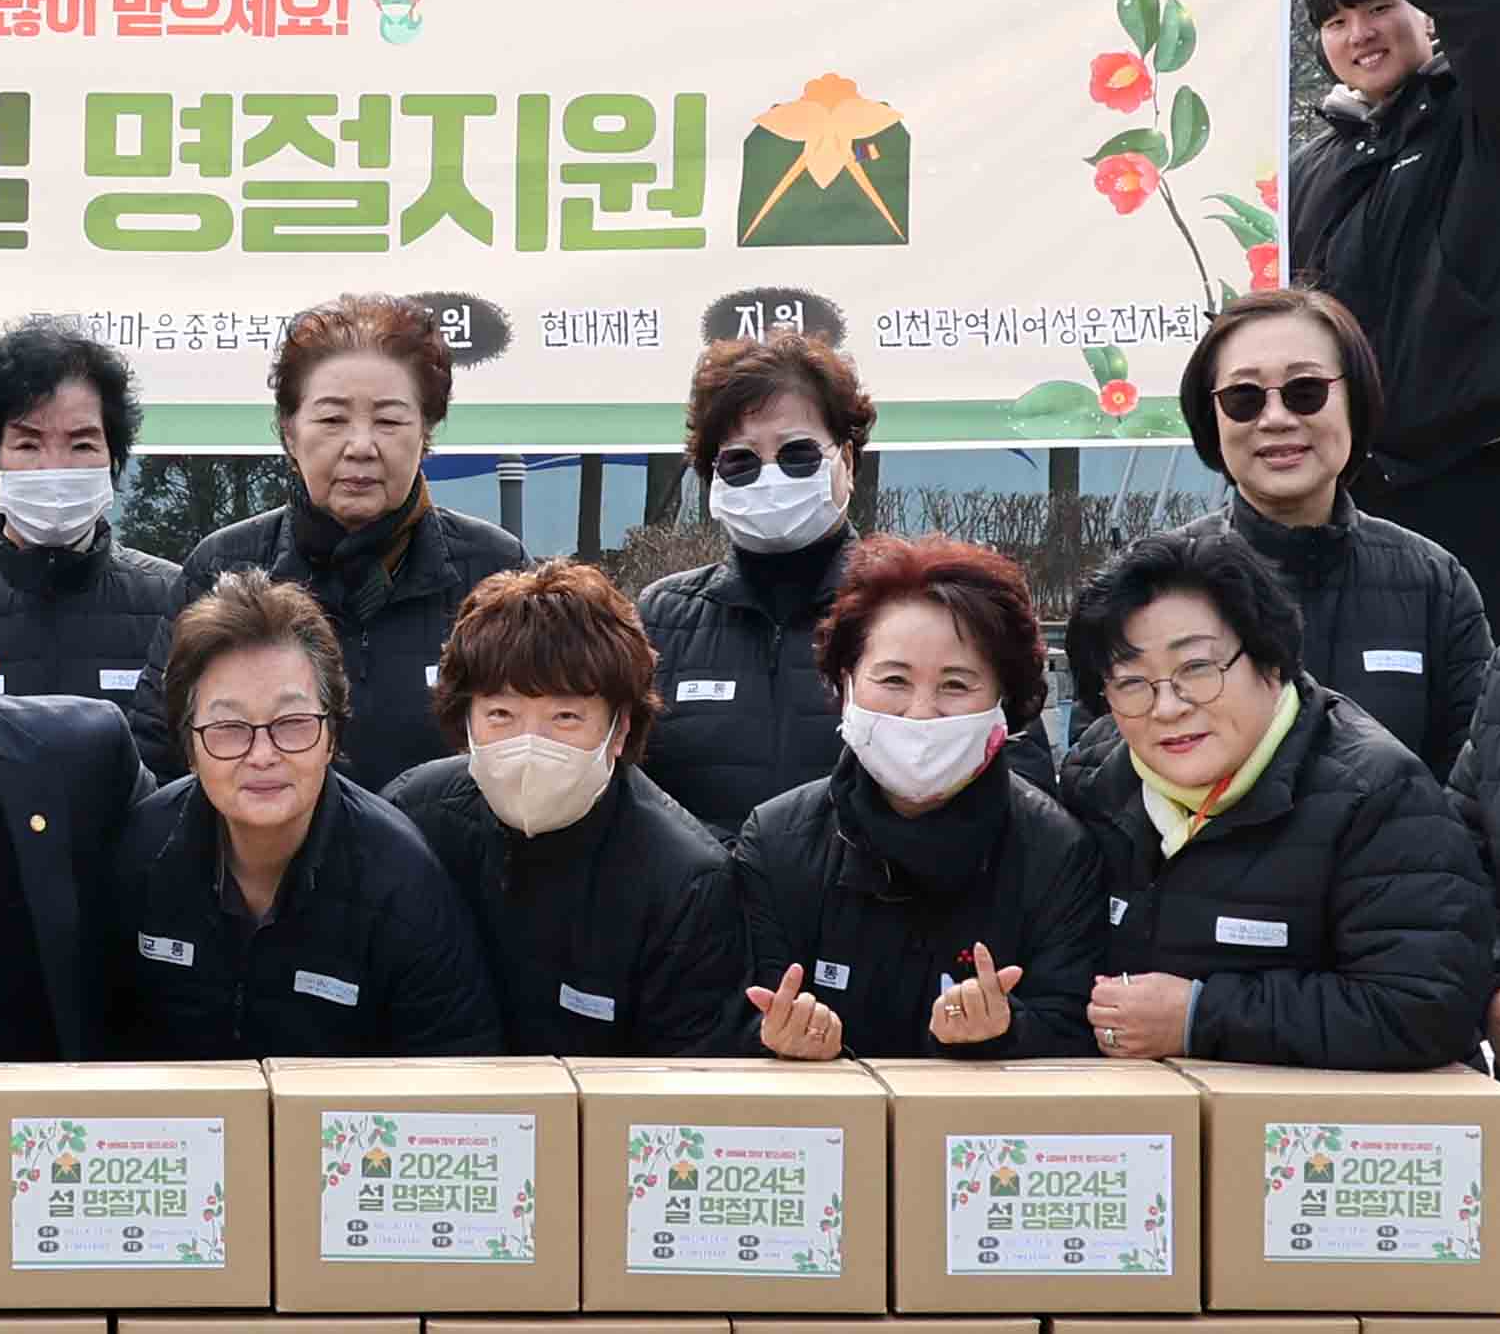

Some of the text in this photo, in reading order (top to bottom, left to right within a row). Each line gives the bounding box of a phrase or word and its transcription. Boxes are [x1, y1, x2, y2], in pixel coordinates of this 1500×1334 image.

[83, 91, 707, 253] 명절지원
[540, 307, 660, 348] 현대제철
[876, 304, 1200, 347] 인천광역시여성운전자회
[89, 1156, 187, 1186] 2024년
[706, 1165, 805, 1194] 2024년
[1343, 1158, 1442, 1185] 2024년
[48, 1188, 188, 1219] 설 명절지원
[665, 1197, 805, 1227] 설 명절지원
[1301, 1189, 1443, 1218] 설 명절지원
